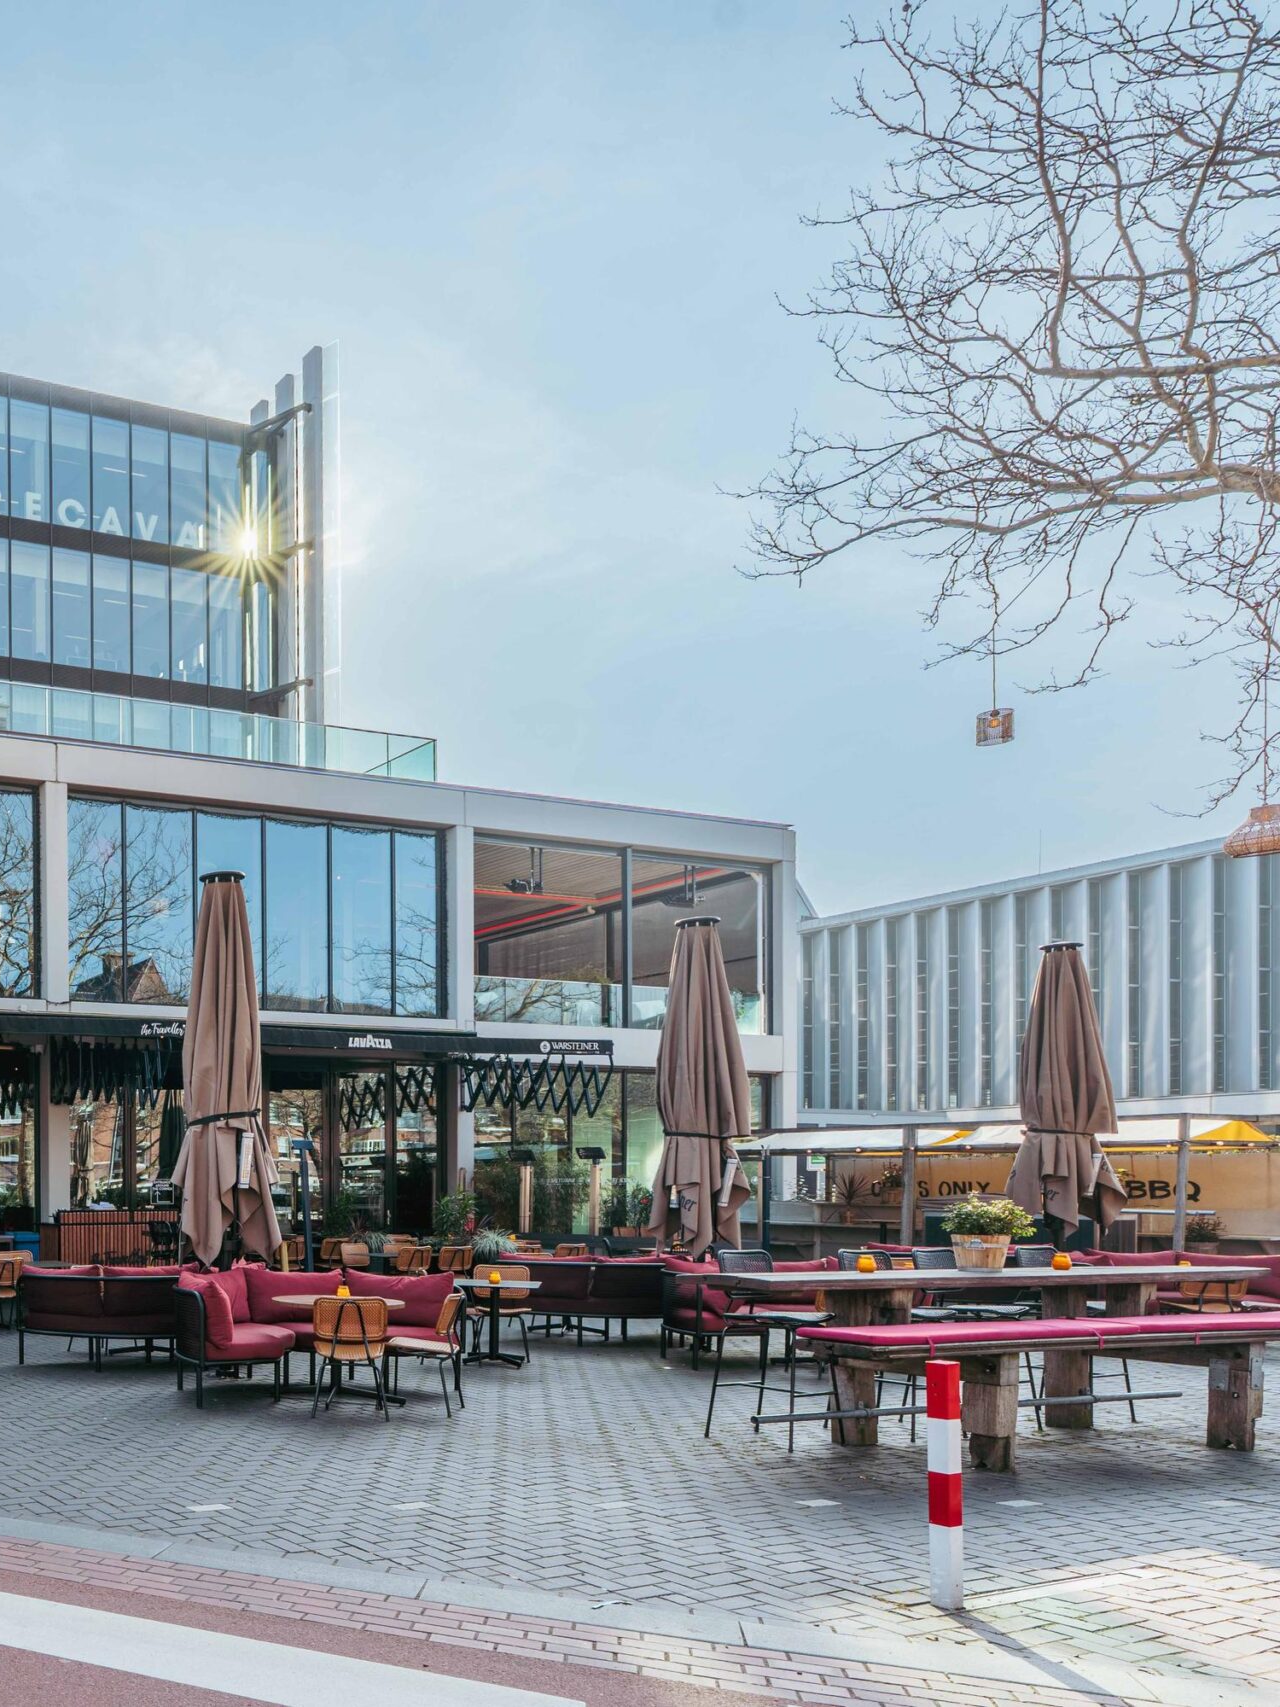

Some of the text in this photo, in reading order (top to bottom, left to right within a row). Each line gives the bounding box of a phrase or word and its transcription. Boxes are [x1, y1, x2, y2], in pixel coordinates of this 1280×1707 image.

[348, 1034, 392, 1049] LAVAZZA
[551, 1041, 599, 1051] WARSTEINER
[938, 1181, 991, 1197] ONLY
[1125, 1180, 1201, 1202] BBQ
